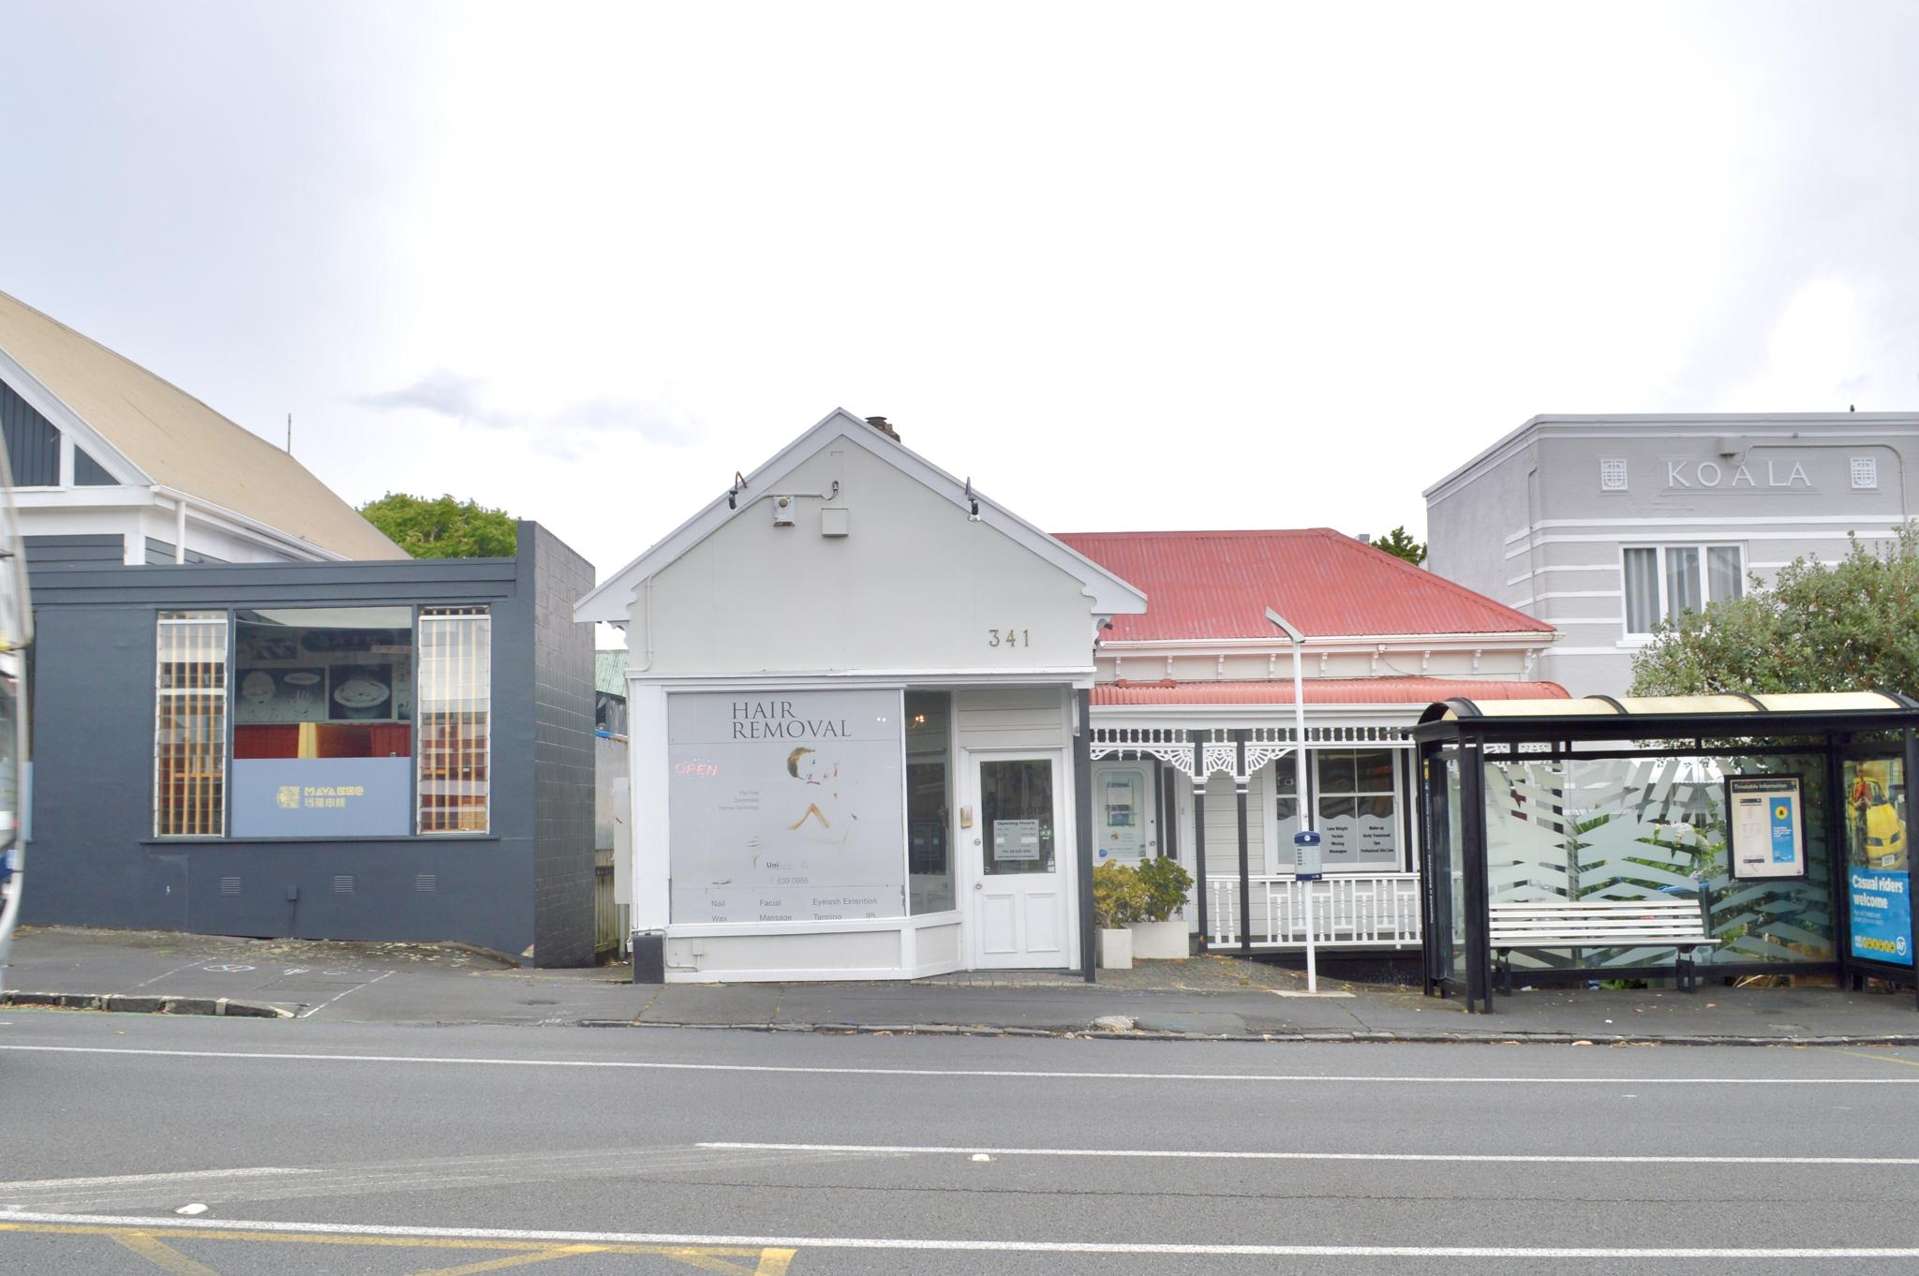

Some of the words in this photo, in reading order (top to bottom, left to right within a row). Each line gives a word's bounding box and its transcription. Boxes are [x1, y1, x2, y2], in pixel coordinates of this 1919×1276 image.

[1667, 460, 1812, 487] KOALA
[988, 628, 1029, 647] 341
[732, 701, 797, 719] HAIR
[732, 720, 852, 739] REMOVAL
[1852, 874, 1878, 891] Casual
[1879, 877, 1904, 894] riders
[1853, 892, 1889, 909] welcome
